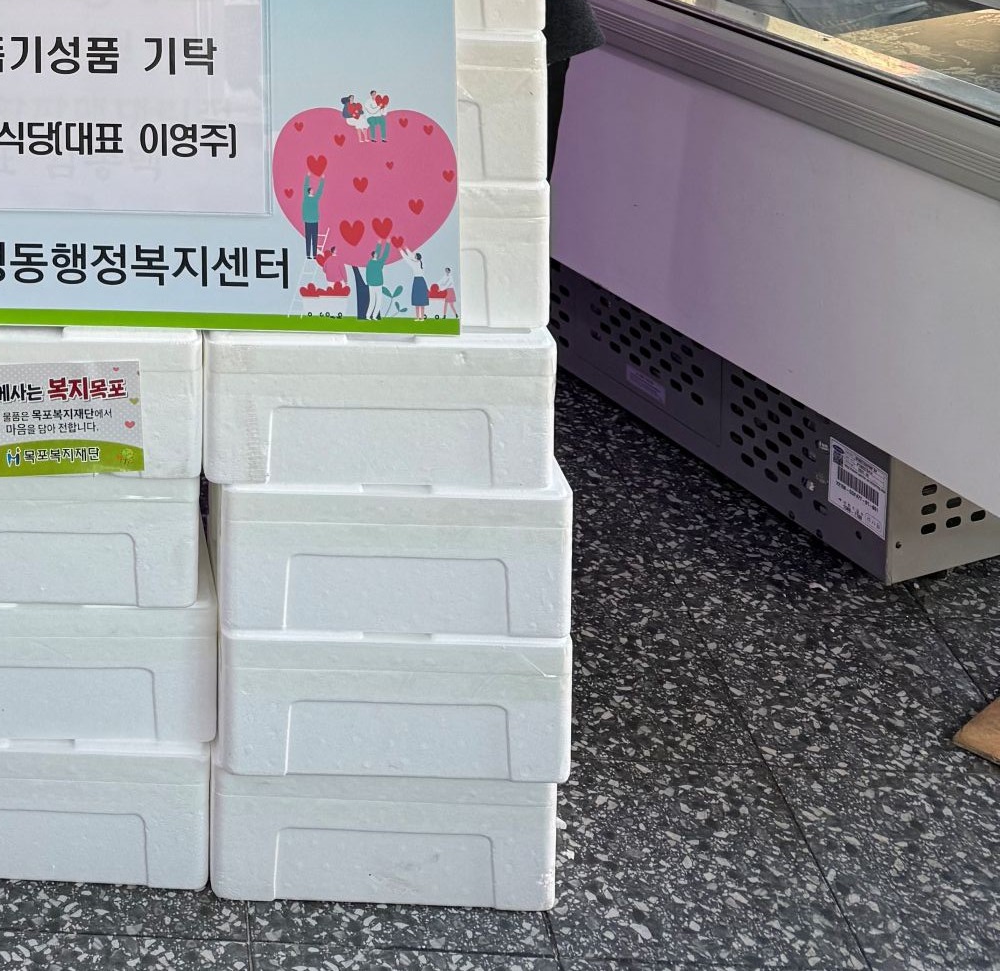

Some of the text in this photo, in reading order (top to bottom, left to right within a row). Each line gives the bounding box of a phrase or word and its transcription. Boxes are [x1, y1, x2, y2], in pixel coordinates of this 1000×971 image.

[143, 35, 218, 77] 기탁
[47, 376, 129, 401] 복지목포
[2, 411, 30, 423] 물품은
[31, 408, 113, 421] 목포복지재단에서
[6, 422, 99, 436] 마음을 담아 전합니다.
[24, 447, 101, 463] 목포복지재단
